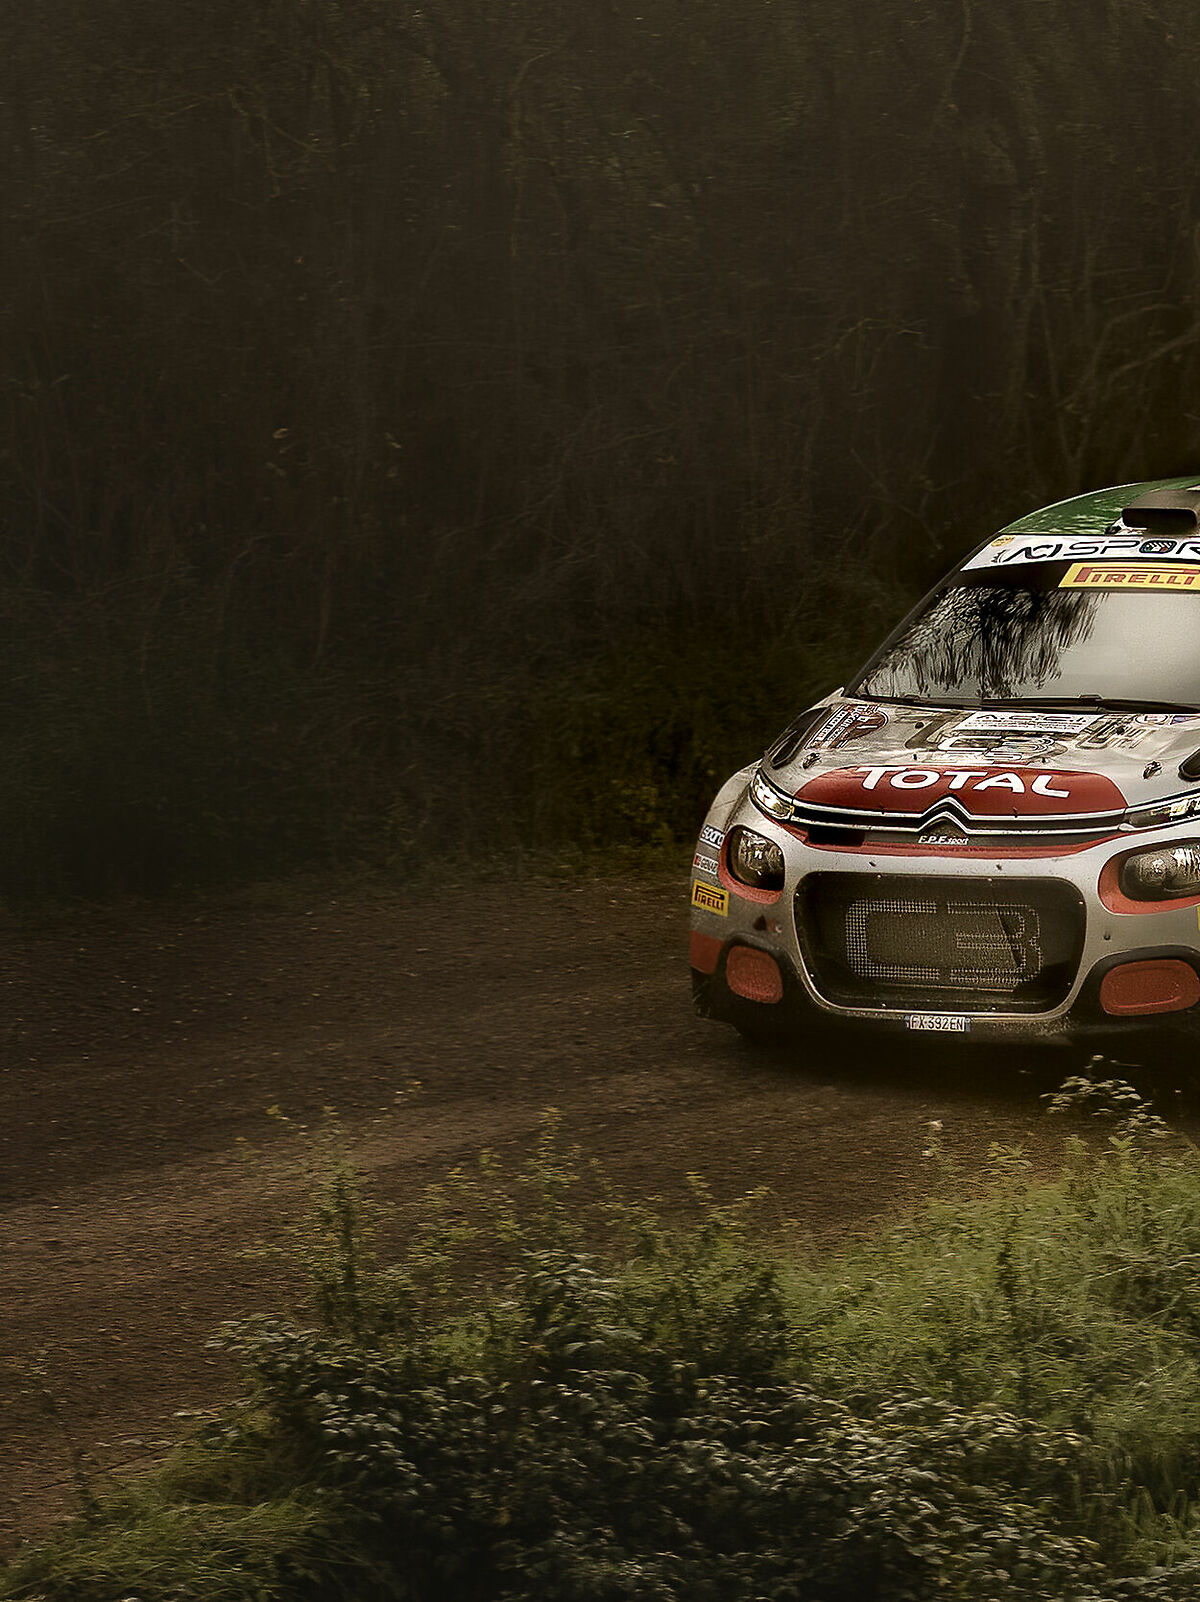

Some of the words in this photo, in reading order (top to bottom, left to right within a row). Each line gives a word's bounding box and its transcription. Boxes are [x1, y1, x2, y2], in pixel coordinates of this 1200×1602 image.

[1073, 567, 1200, 585] PIRELLI
[855, 766, 1070, 799] TOTAL
[695, 885, 725, 911] PIRELLI
